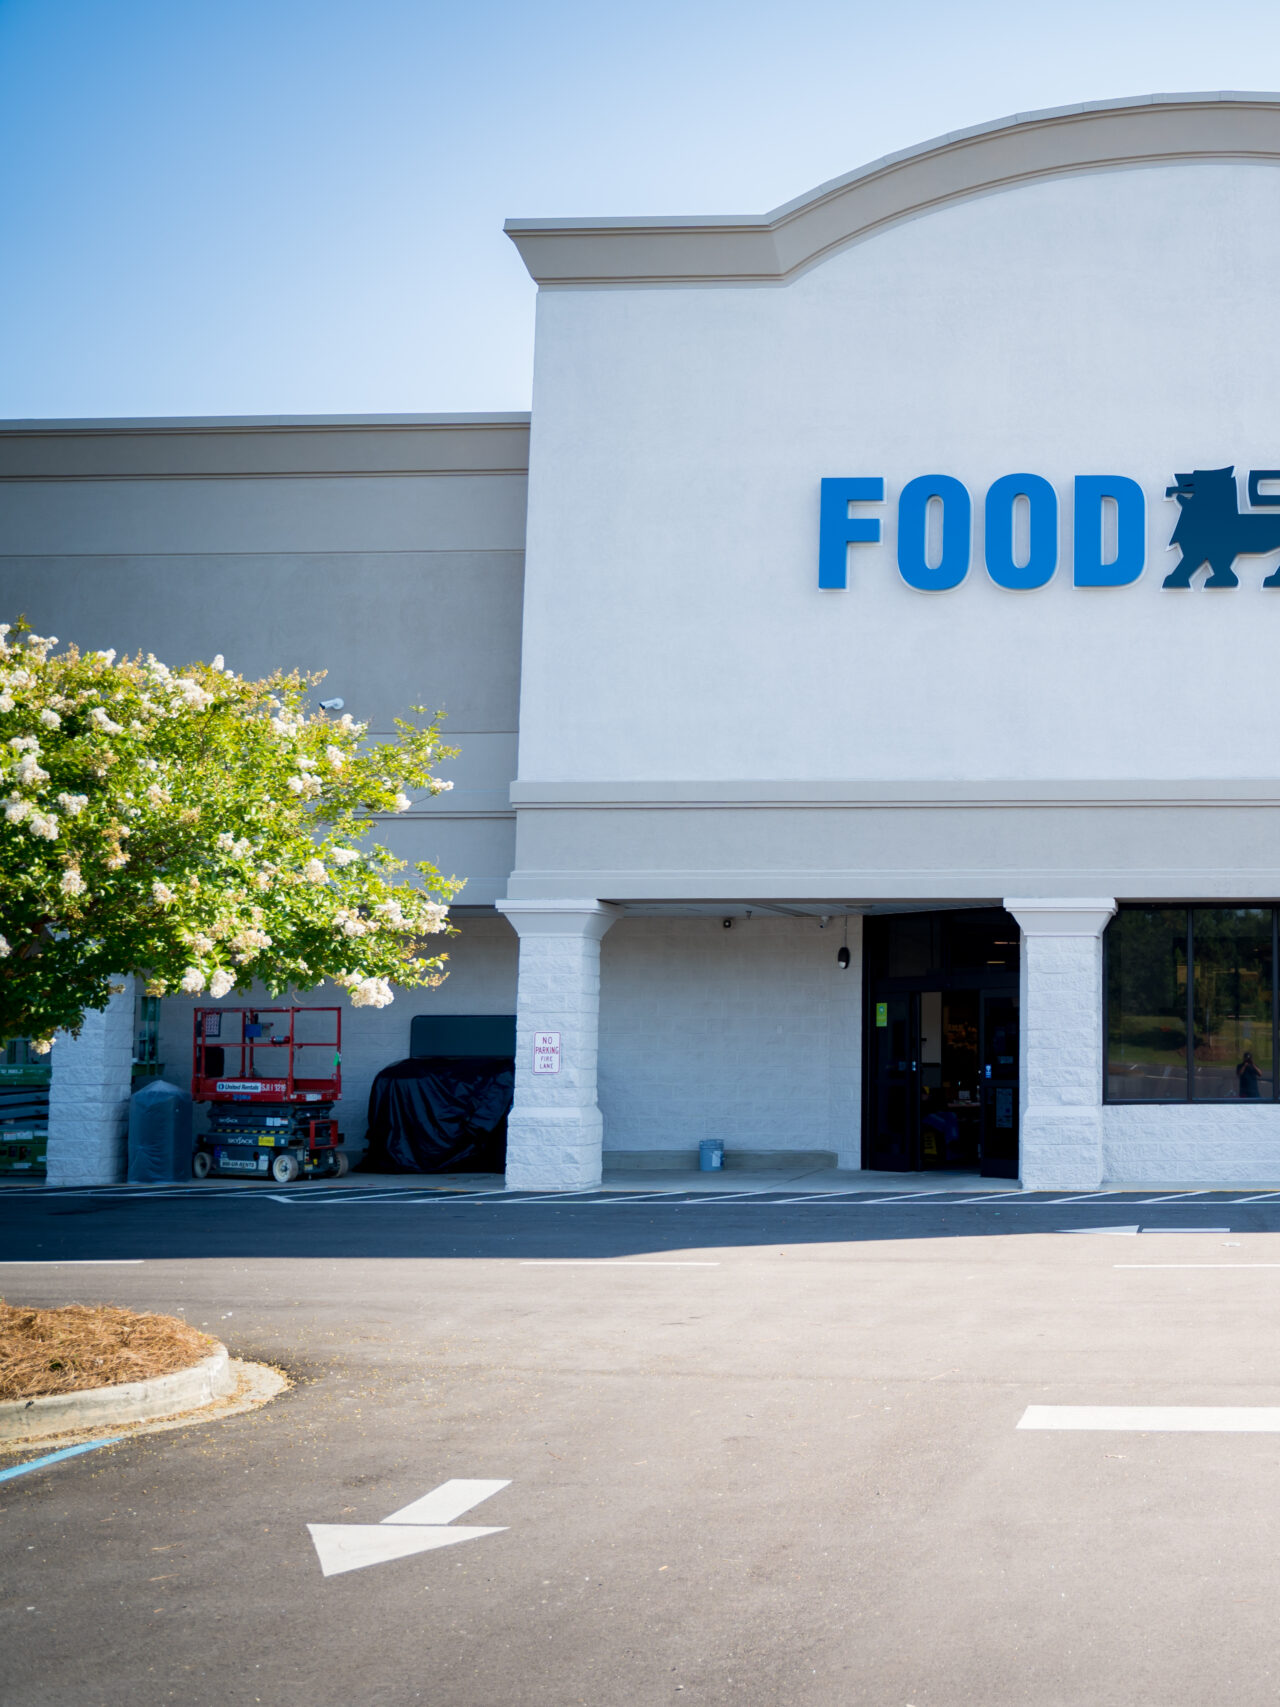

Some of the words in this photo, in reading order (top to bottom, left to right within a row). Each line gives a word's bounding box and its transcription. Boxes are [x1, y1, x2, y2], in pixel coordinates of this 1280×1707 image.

[818, 474, 1147, 590] FOOD
[542, 1036, 553, 1044] NO
[535, 1046, 559, 1054] PARKING
[227, 1136, 253, 1144] SKYJACK
